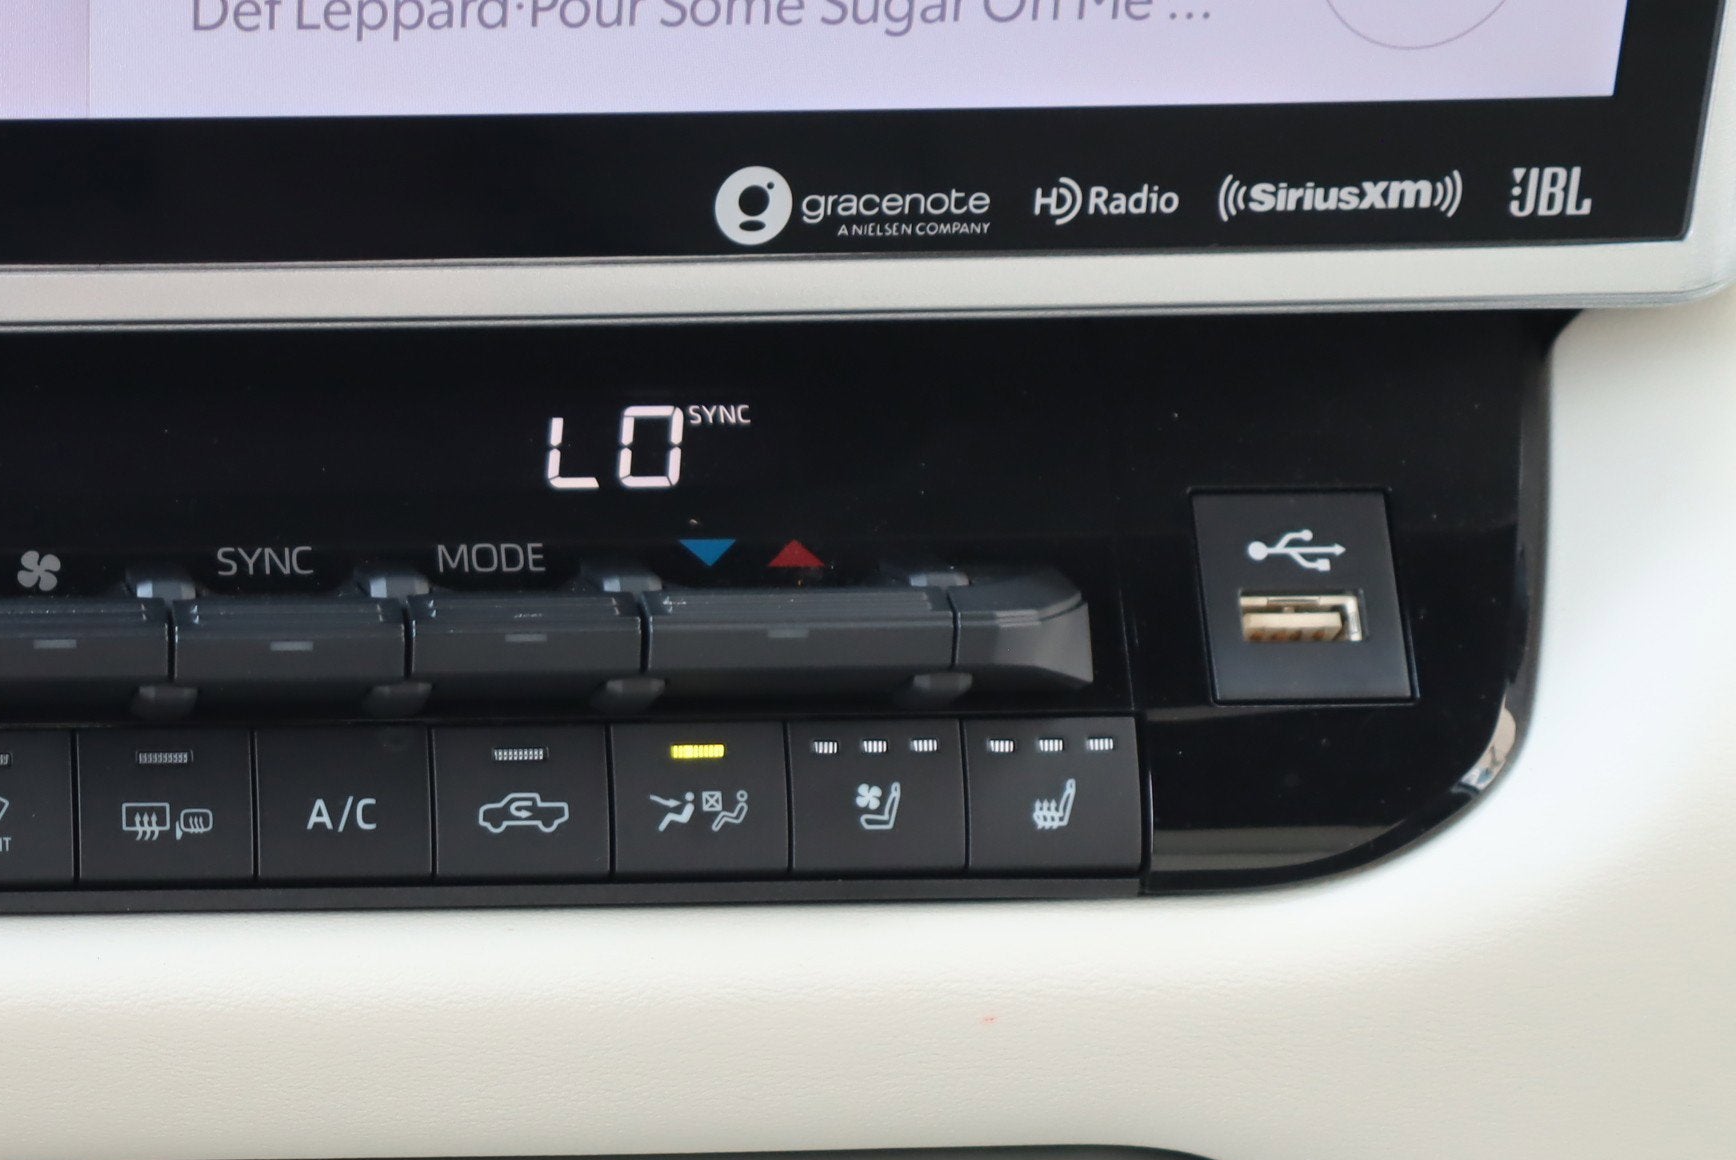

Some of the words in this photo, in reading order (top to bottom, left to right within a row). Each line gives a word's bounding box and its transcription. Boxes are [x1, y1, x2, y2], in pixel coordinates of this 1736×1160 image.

[660, 0, 804, 28] Some
[820, 0, 963, 38] Sugar
[801, 188, 991, 225] gracenote
[1087, 183, 1180, 215] Radio
[1510, 166, 1592, 217] JBL
[837, 224, 850, 237] A
[851, 222, 912, 237] NIELSEN
[915, 221, 992, 236] COMPANY
[688, 404, 752, 425] SYNC
[217, 545, 315, 576] SYNC
[436, 542, 547, 573] MODE
[306, 795, 378, 833] A/C
